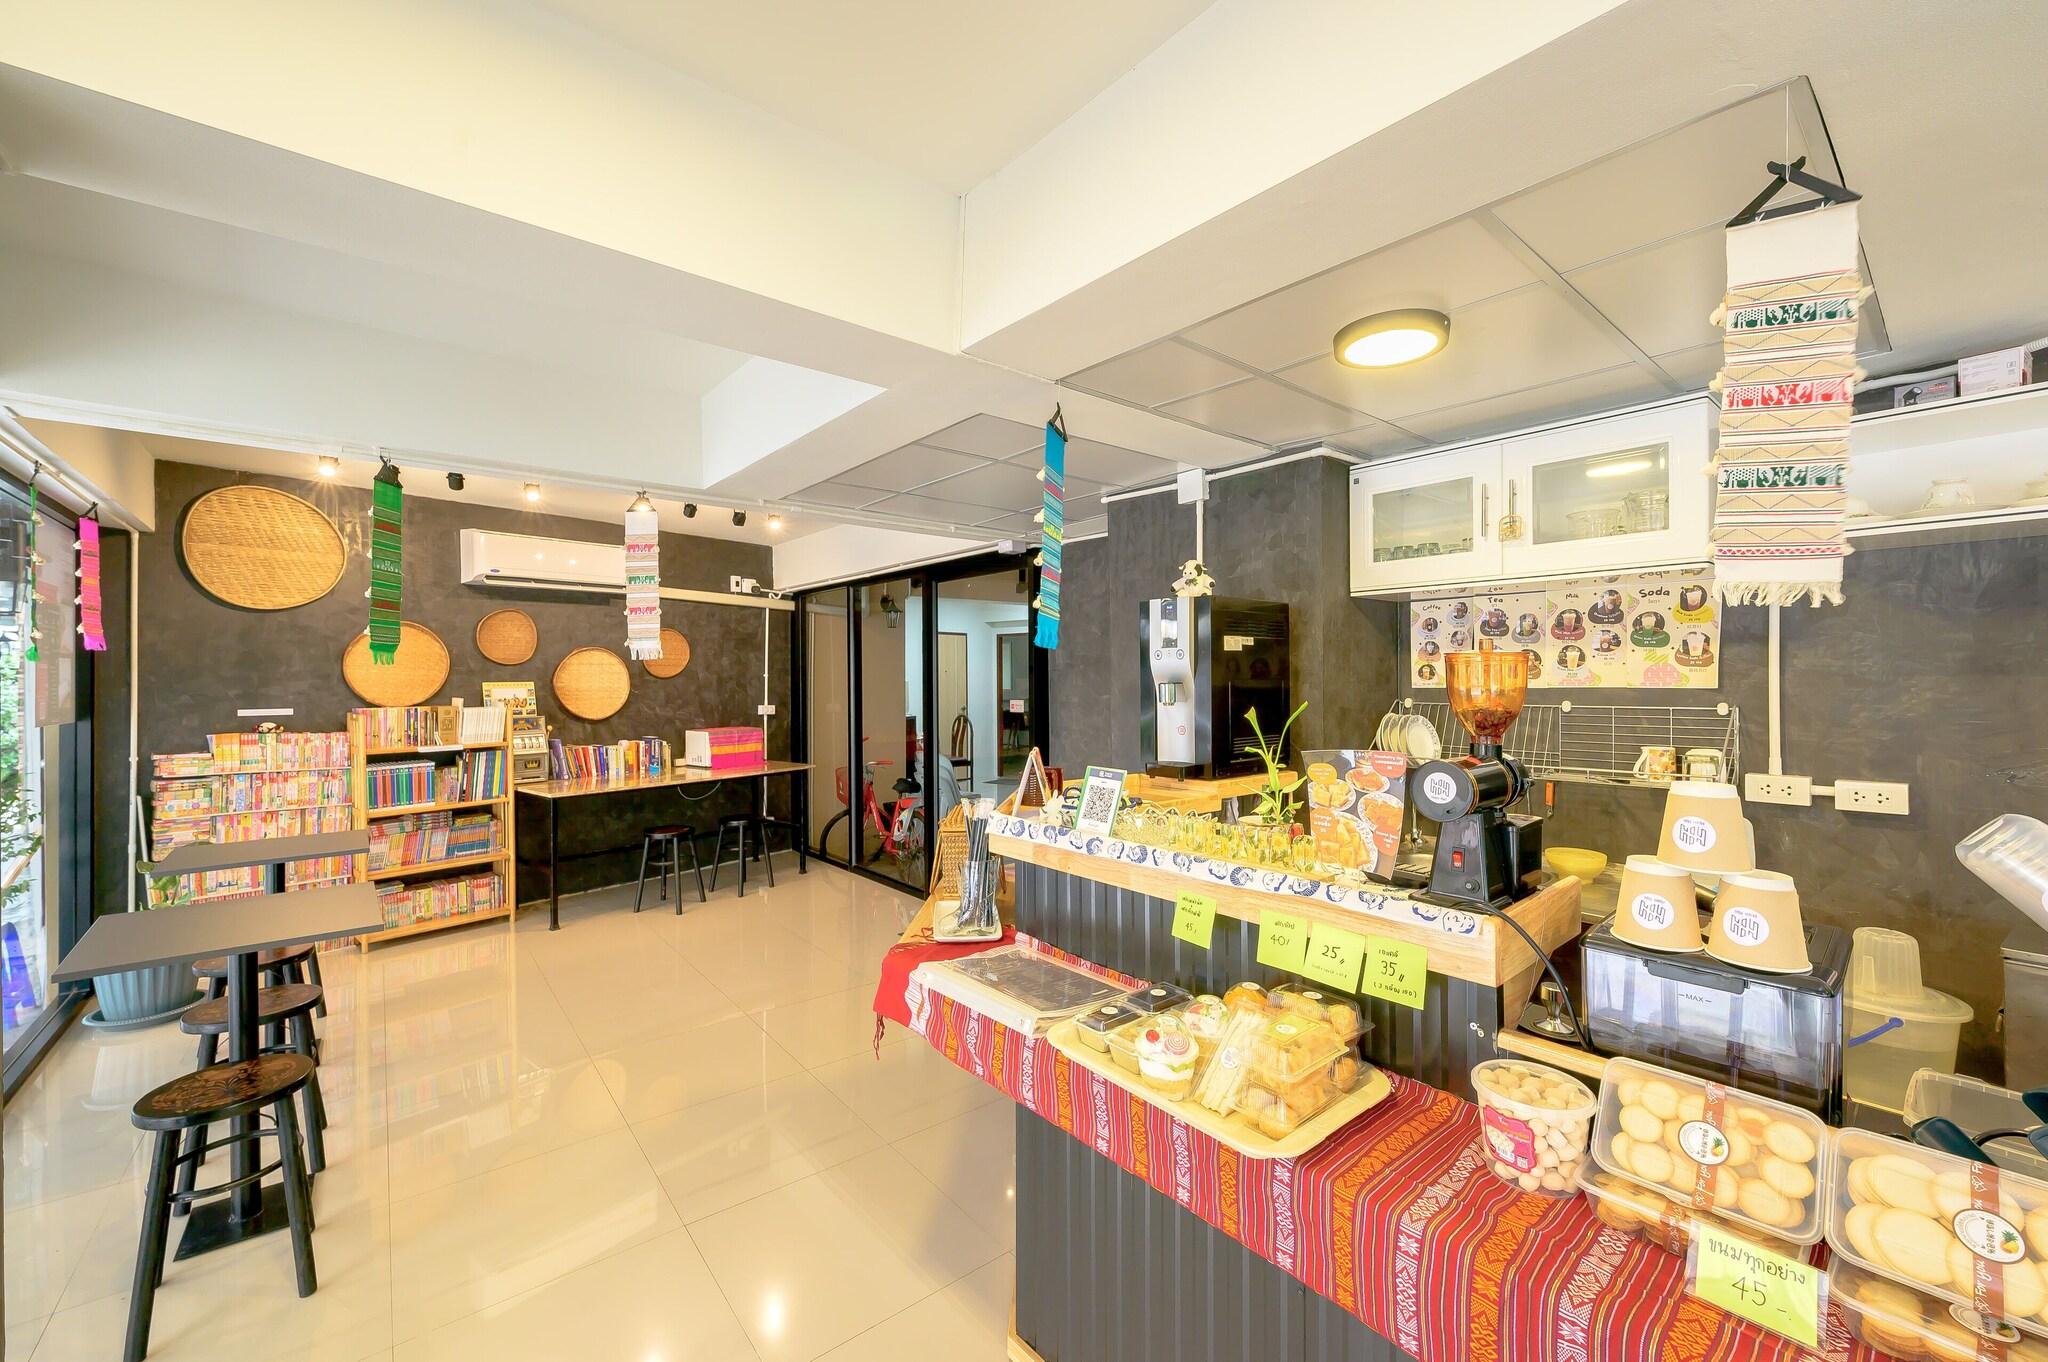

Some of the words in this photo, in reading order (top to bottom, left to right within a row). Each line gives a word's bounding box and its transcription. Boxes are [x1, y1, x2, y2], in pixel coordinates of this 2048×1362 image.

[1487, 596, 1504, 604] Tea
[1638, 586, 1671, 598] Soda
[1422, 604, 1442, 612] Coffee
[1321, 944, 1341, 959] 25
[1380, 960, 1398, 977] 35
[1685, 993, 1704, 1004] MAX
[1708, 1237, 1806, 1285] ขนมทุกอย่าง
[1975, 1260, 1992, 1281] you
[1731, 1275, 1768, 1307] 45
[1974, 1280, 1987, 1298] For
